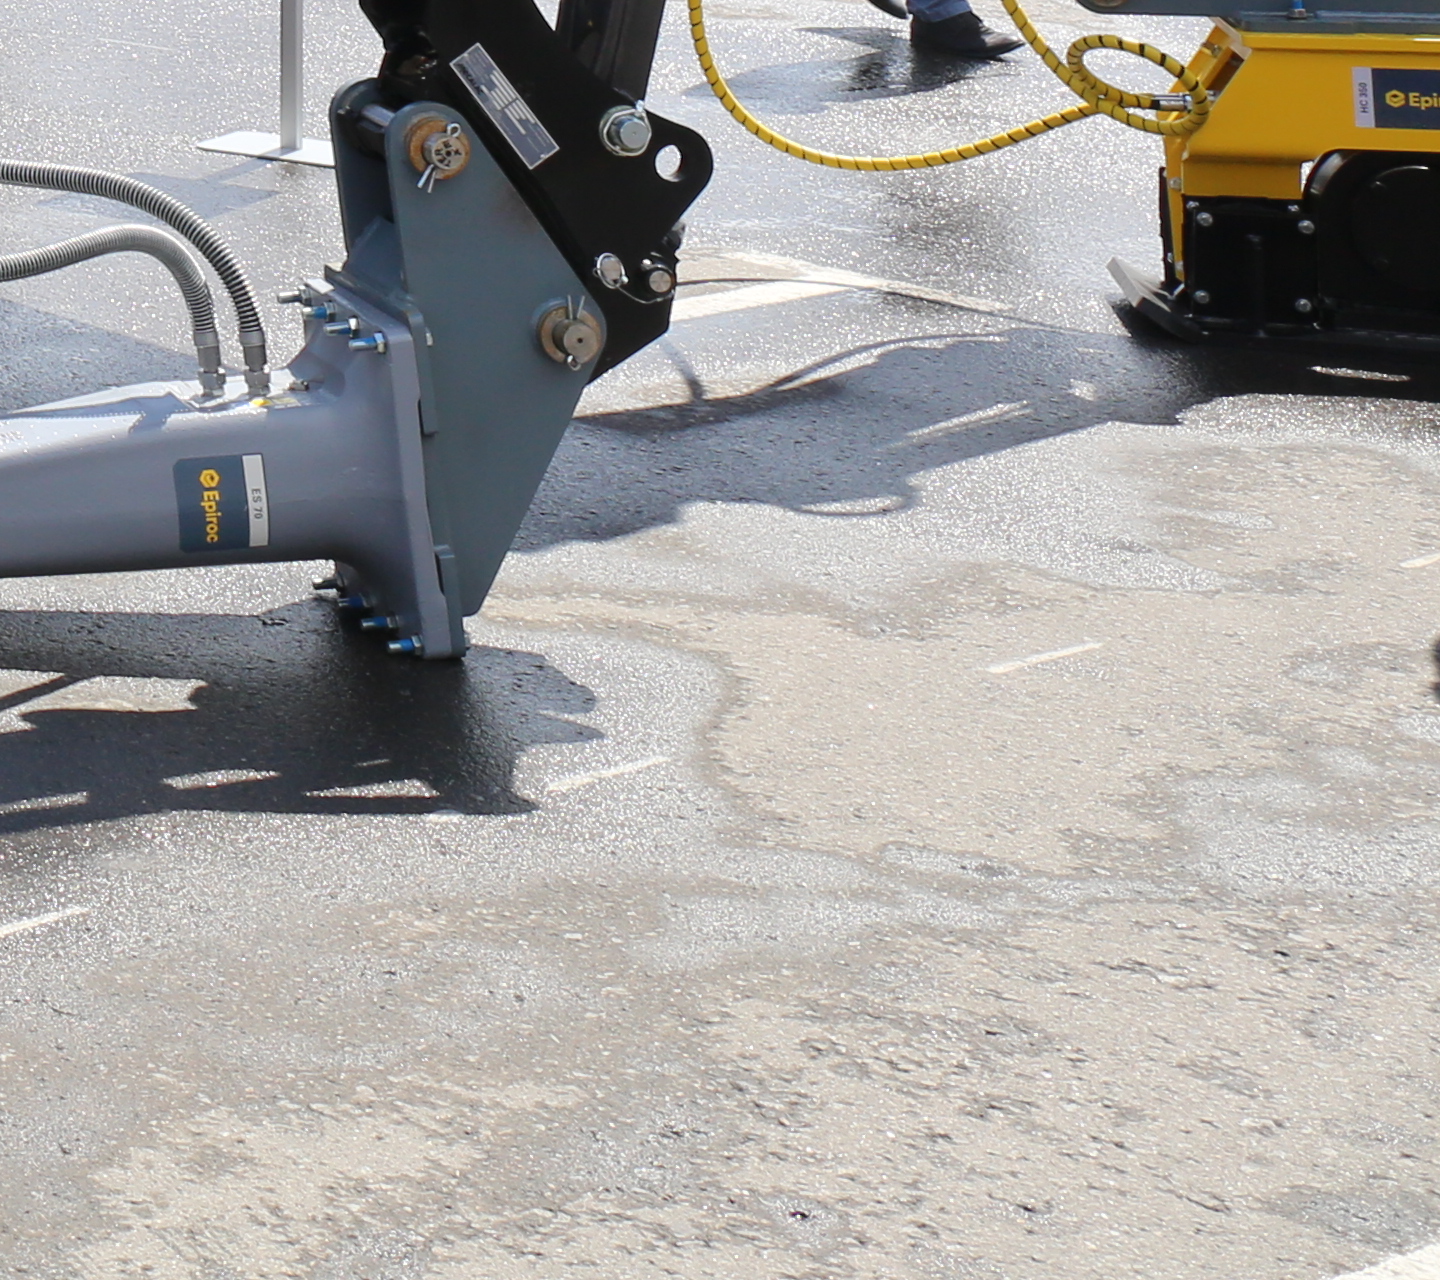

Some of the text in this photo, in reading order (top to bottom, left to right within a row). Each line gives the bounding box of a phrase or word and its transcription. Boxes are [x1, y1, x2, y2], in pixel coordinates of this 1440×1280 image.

[200, 490, 222, 544] Epiroc
[251, 488, 264, 520] ES 70
